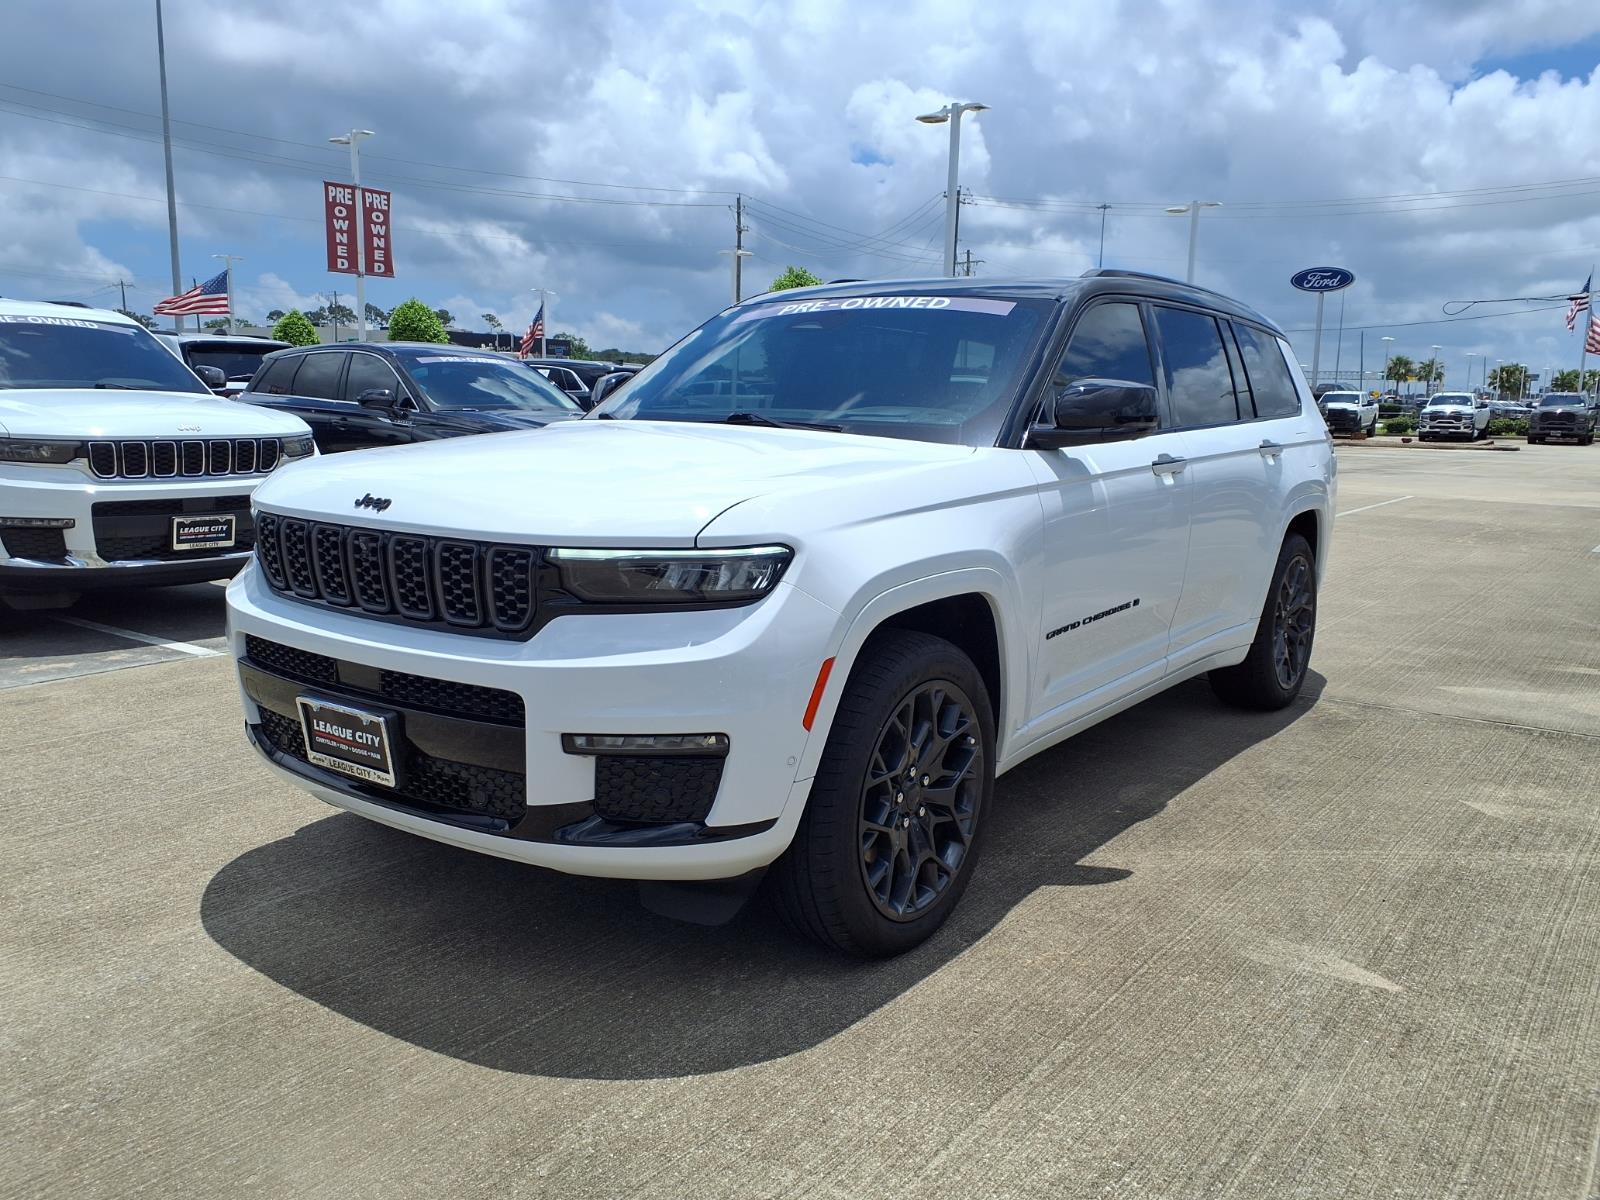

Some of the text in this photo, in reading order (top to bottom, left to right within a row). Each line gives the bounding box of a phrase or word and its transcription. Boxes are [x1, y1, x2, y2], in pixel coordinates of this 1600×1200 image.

[327, 185, 353, 205] PRE
[364, 191, 389, 210] PRE
[332, 206, 349, 269] OWNED
[370, 211, 386, 273] OWNED
[1303, 272, 1341, 288] Ford
[777, 296, 950, 316] PRE-OWNED
[354, 492, 392, 513] Jeep
[180, 526, 209, 534] LEAGUE
[1046, 621, 1081, 640] GRAND
[1082, 601, 1132, 625] CHEROKEE
[313, 719, 380, 748] LEAGUE CITY
[329, 758, 355, 775] LEAGUE
[356, 767, 371, 778] CITY
